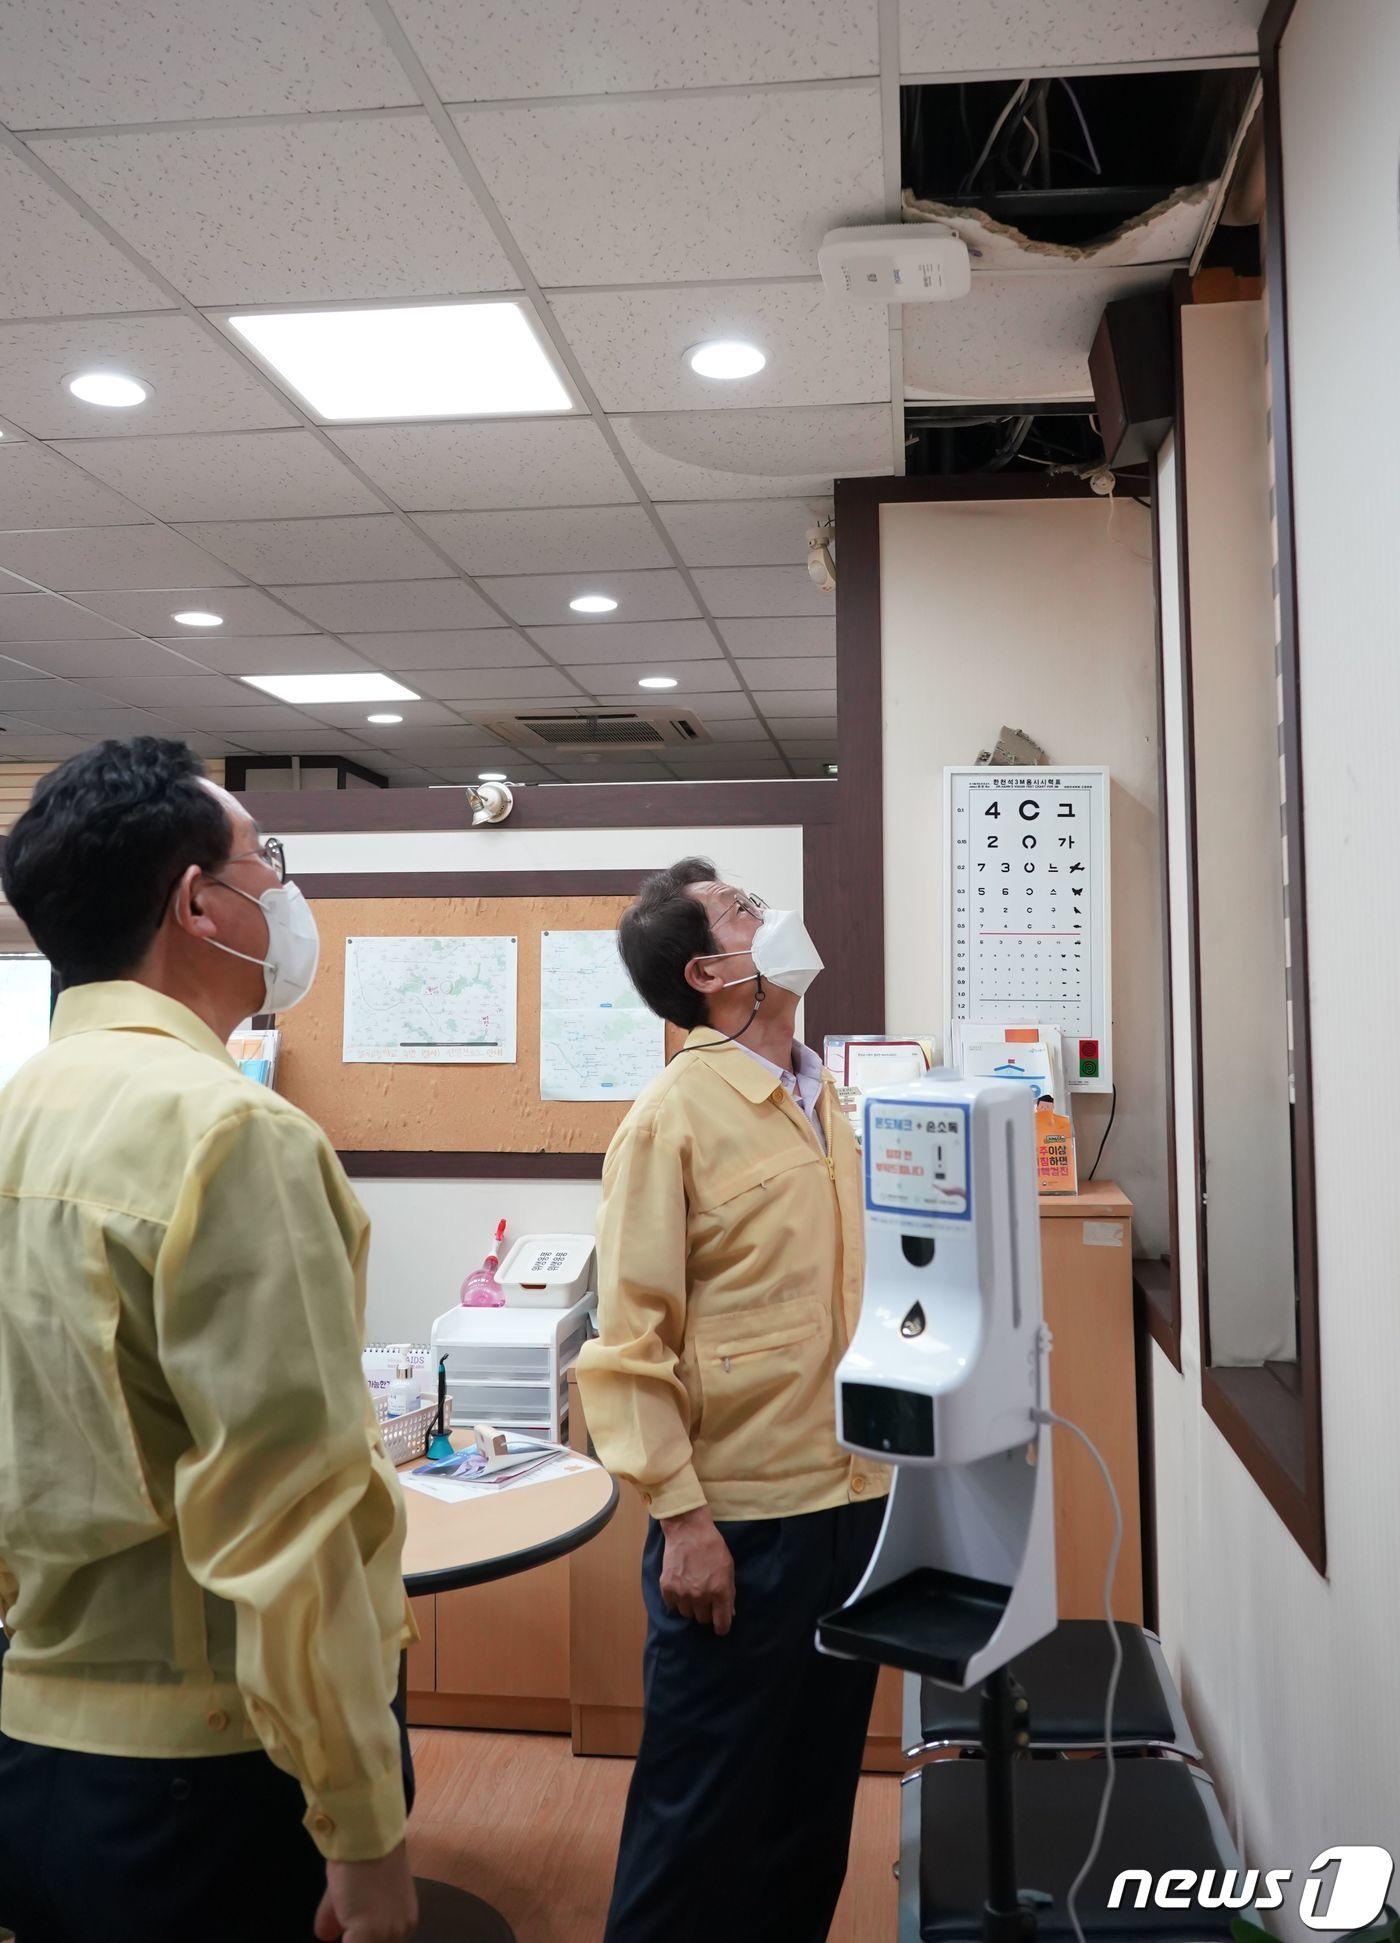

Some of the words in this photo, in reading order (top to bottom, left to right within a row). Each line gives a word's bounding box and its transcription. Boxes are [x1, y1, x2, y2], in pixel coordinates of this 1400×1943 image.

[984, 801, 1001, 819] 4
[1057, 803, 1076, 818] 그
[987, 836, 999, 848] 2
[1058, 835, 1075, 849] 가
[977, 863, 986, 872] 7
[1000, 863, 1010, 873] 3
[1048, 863, 1059, 873] 느
[977, 887, 986, 896] 5
[1002, 888, 1010, 896] 6
[1037, 1156, 1068, 1167] 침하면
[1037, 1167, 1069, 1177] 핵검진
